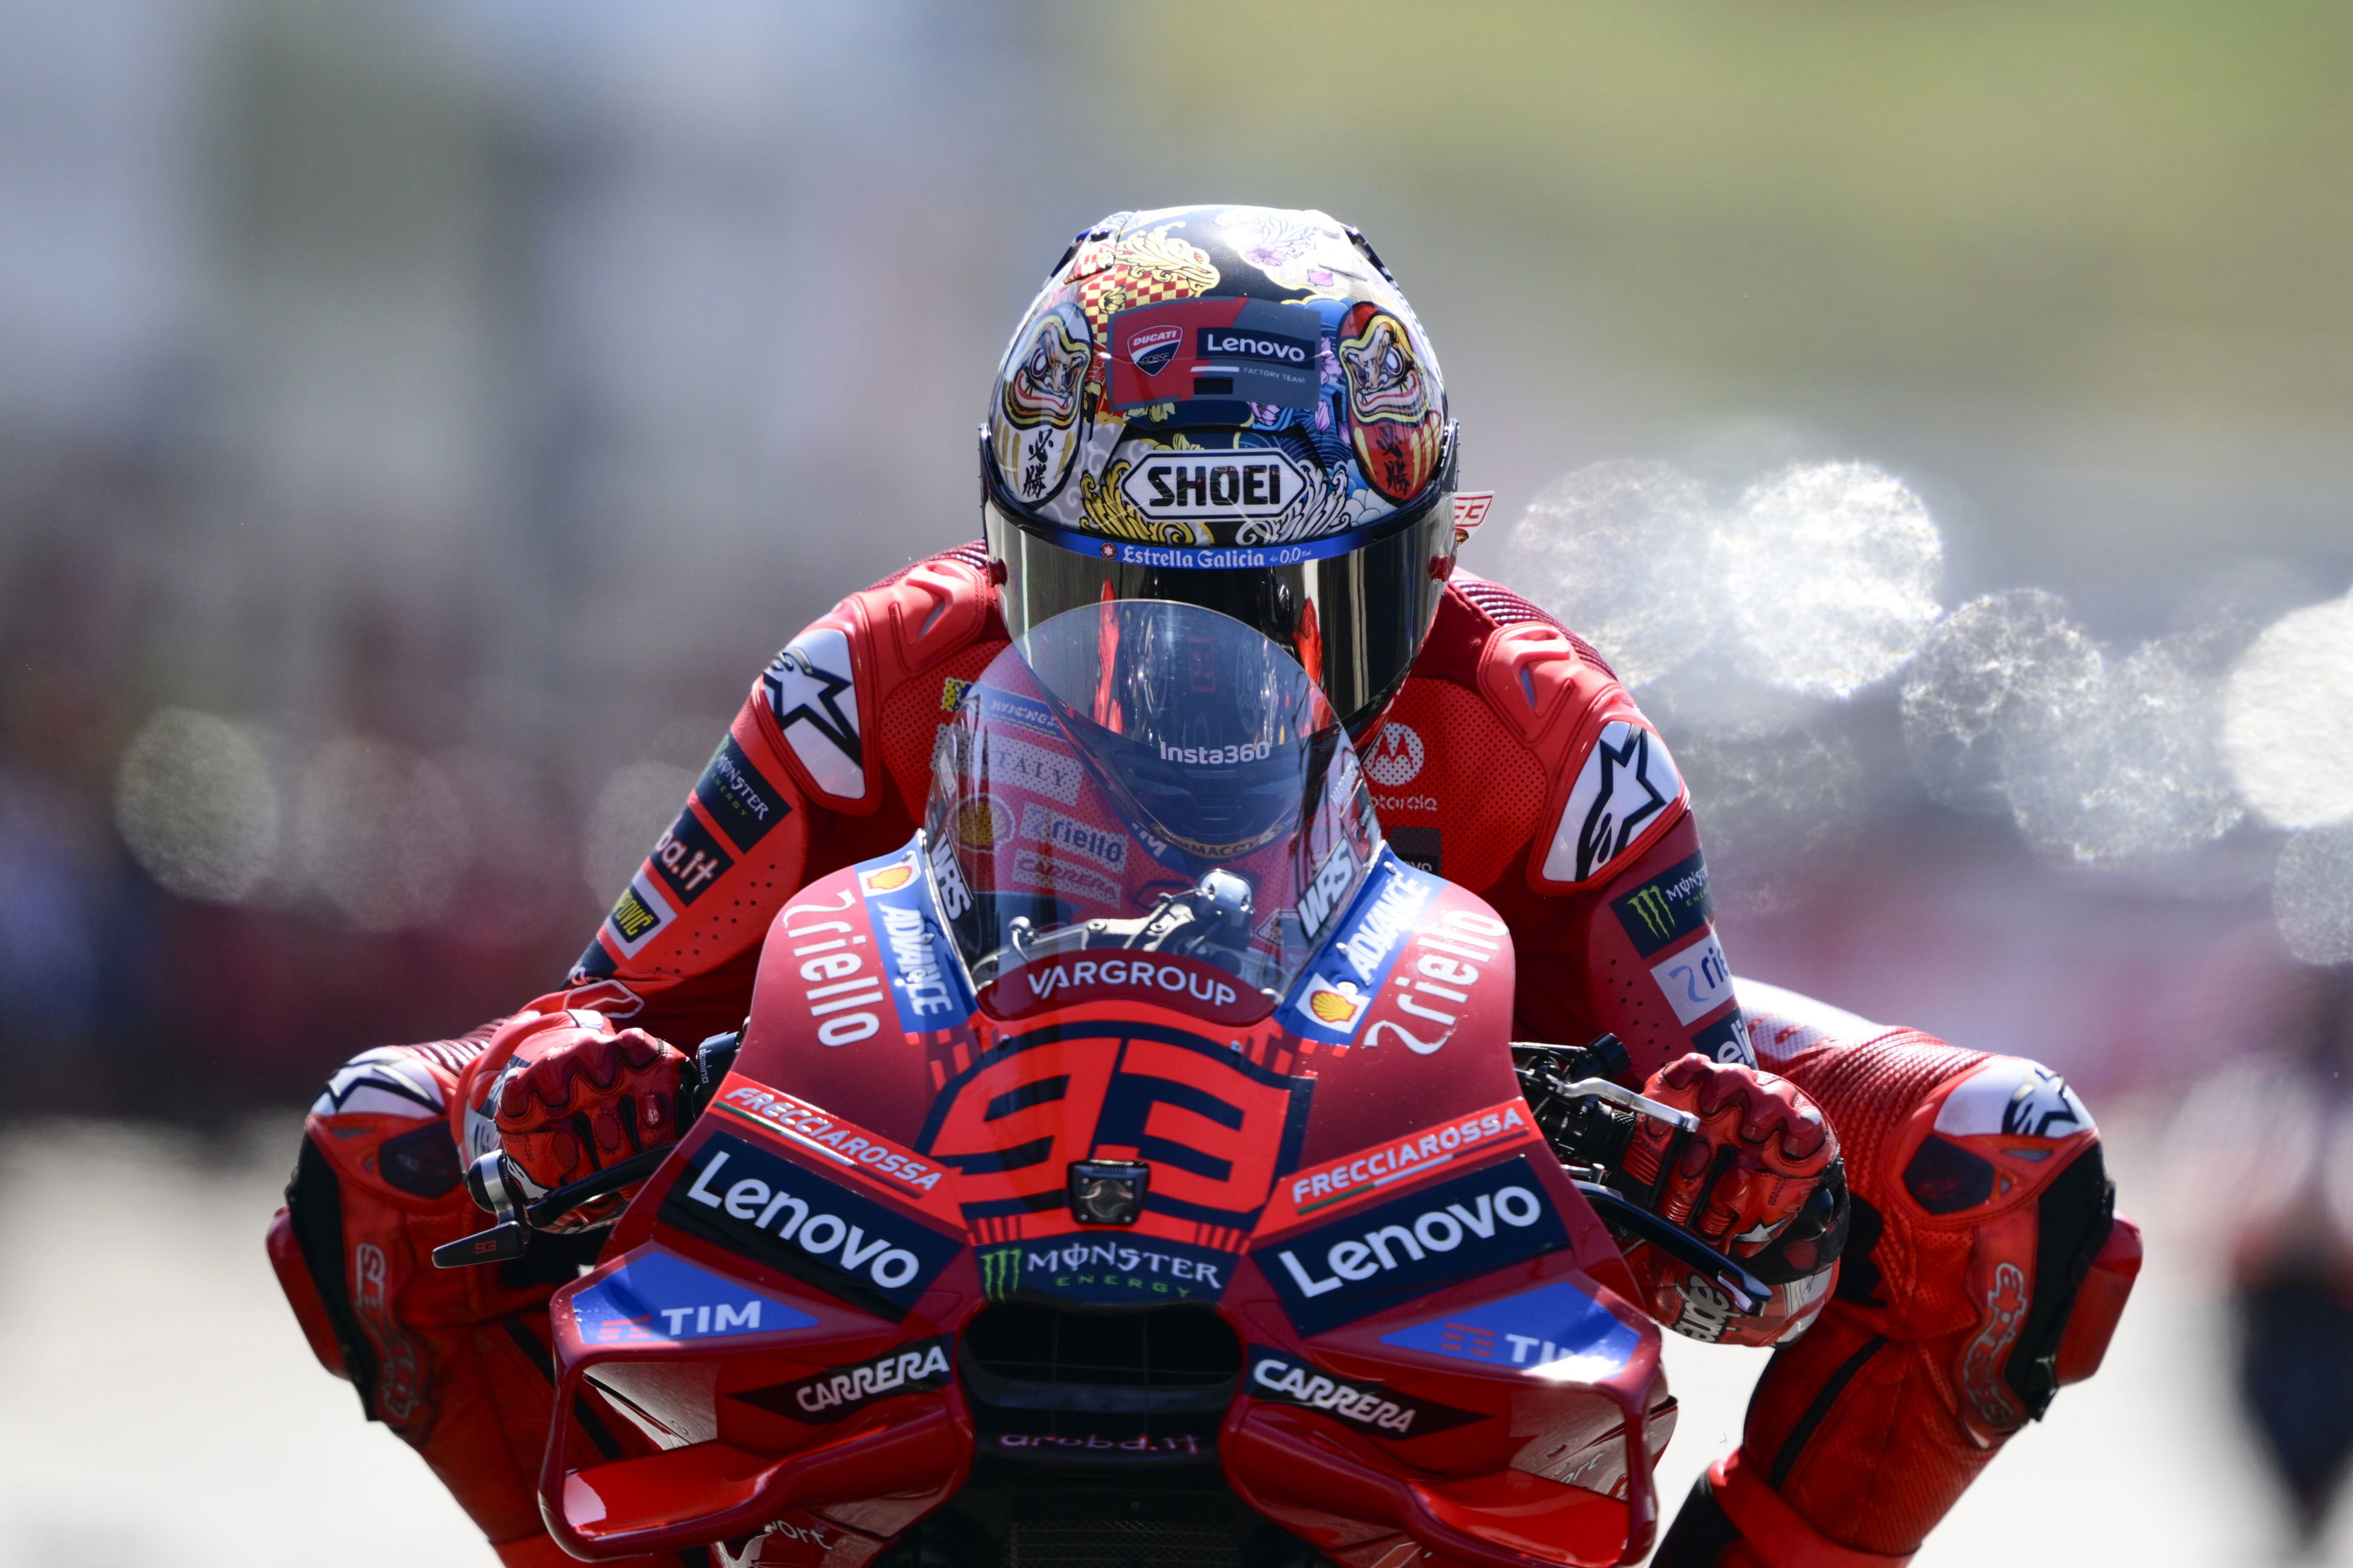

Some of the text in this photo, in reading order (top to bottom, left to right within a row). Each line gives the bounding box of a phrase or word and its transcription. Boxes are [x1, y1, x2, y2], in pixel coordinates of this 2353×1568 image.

[1133, 330, 1177, 346] DUCATI
[1208, 334, 1305, 362] Lenovo
[1243, 366, 1306, 384] FACTORY TEAM
[1147, 464, 1281, 506] SHOEI
[1123, 545, 1193, 567] Estrella
[1198, 550, 1265, 567] Galicia
[1160, 741, 1270, 764] Insta360
[717, 753, 769, 821] MONSTER
[1371, 794, 1437, 812] otorola
[1052, 821, 1123, 862] riello
[930, 836, 971, 920] WRS
[1298, 844, 1353, 939] WRS
[1666, 864, 1708, 902] MONSTE
[787, 920, 884, 1047] riello
[877, 902, 953, 1017] ADVANCE
[1028, 960, 1236, 1006] VARGROUP
[1395, 909, 1509, 1026] riello
[725, 1087, 943, 1190] FRECCIAROSSA
[929, 1037, 1291, 1213] 93
[1293, 1107, 1524, 1203] FRECCIAROSSA
[687, 1151, 919, 1289] Lenovo
[1279, 1186, 1541, 1298] Lenovo
[1028, 1242, 1222, 1289] MONSTER
[1057, 1275, 1191, 1298] ENERGY
[661, 1300, 761, 1335] TIM
[797, 1345, 949, 1412] CARRERA
[1253, 1358, 1417, 1433] CARRERA
